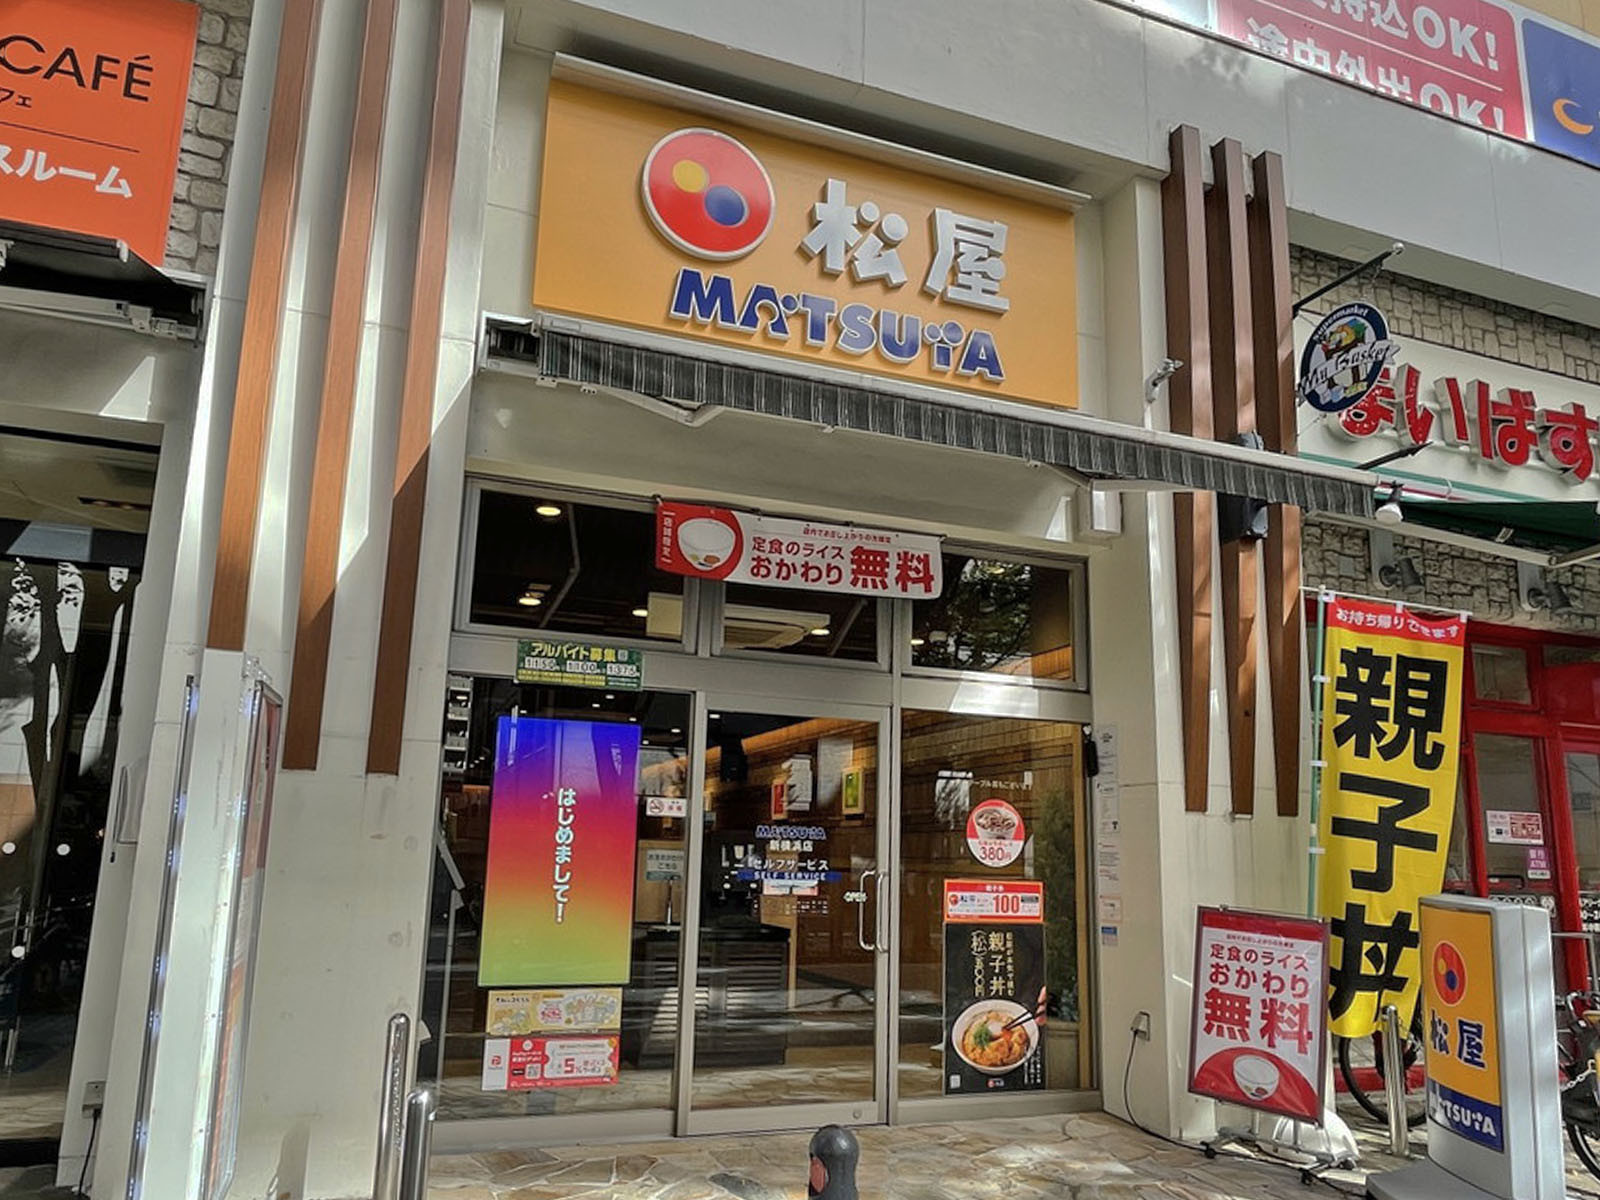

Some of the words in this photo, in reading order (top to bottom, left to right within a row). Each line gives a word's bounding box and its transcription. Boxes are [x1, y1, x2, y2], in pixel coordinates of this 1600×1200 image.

[0, 34, 154, 102] CAFÉ
[801, 178, 1009, 313] 松屋
[669, 267, 1005, 383] MATSUYA
[750, 556, 843, 585] おかわり
[751, 536, 846, 561] 定食のライス
[849, 545, 935, 594] 無料
[1336, 607, 1460, 638] お持ち帰りできます
[552, 787, 577, 924] はじめまして!
[1328, 646, 1448, 1022] 親子丼
[753, 859, 830, 871] セルフサービス
[754, 871, 778, 880] SELF
[784, 872, 826, 881] SERVICE
[1209, 943, 1309, 972] 定食のライス
[1209, 962, 1310, 999] おかわり
[1203, 987, 1313, 1056] 無料
[1430, 1008, 1487, 1071] 松屋
[1429, 1091, 1497, 1137] TSUYA
